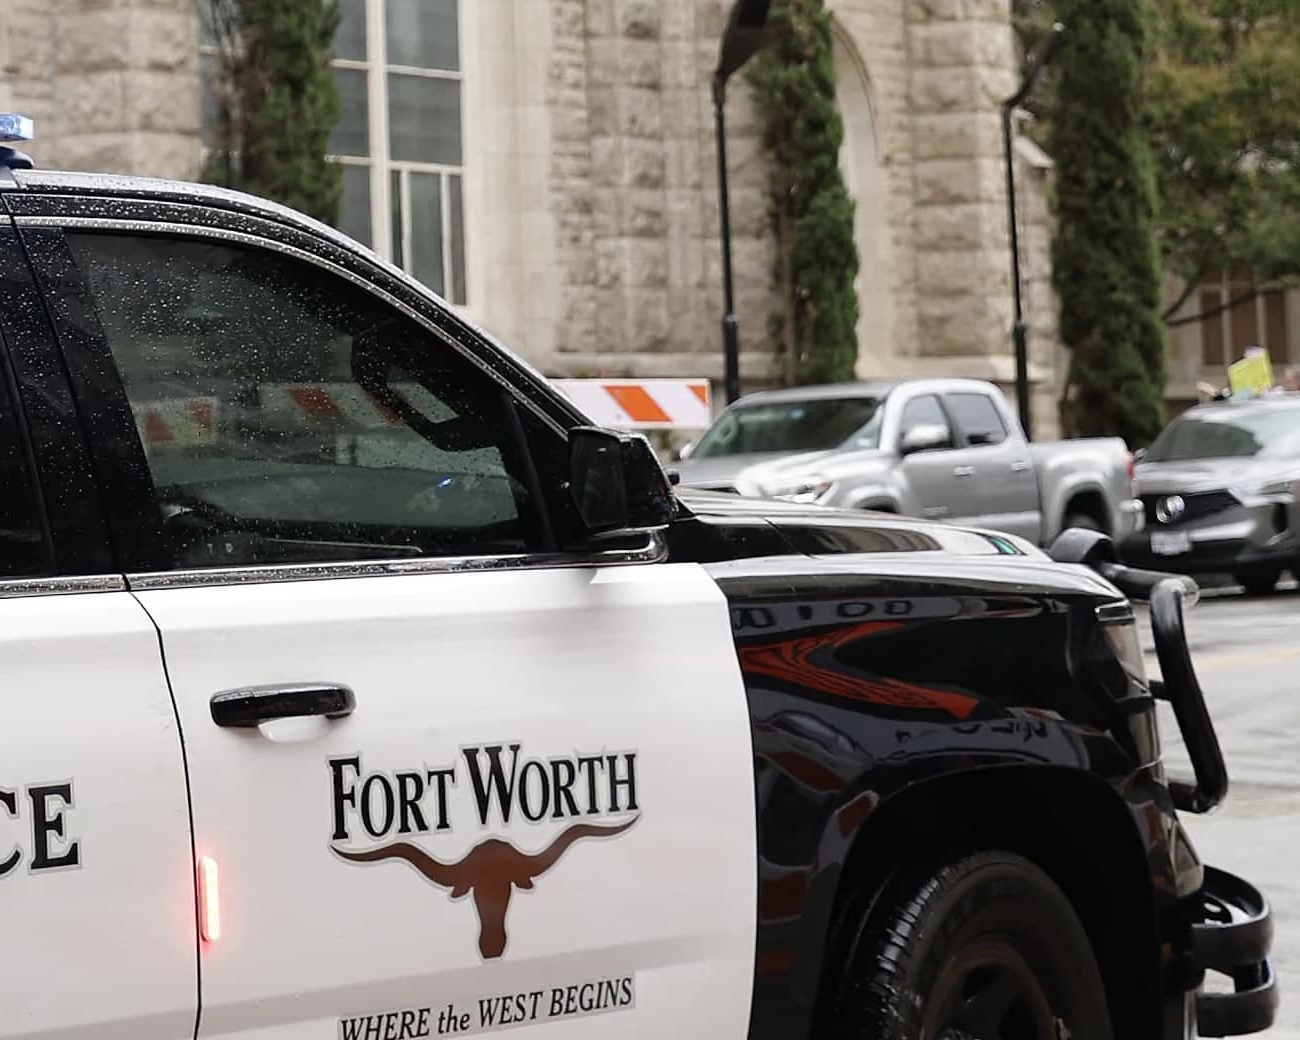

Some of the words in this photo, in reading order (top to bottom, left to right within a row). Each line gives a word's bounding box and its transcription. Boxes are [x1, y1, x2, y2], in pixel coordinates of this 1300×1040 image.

[328, 755, 455, 840] FORT
[462, 744, 638, 824] WORTH
[438, 1004, 471, 1035] the
[478, 990, 544, 1028] WEST
[549, 977, 633, 1018] BEGINS
